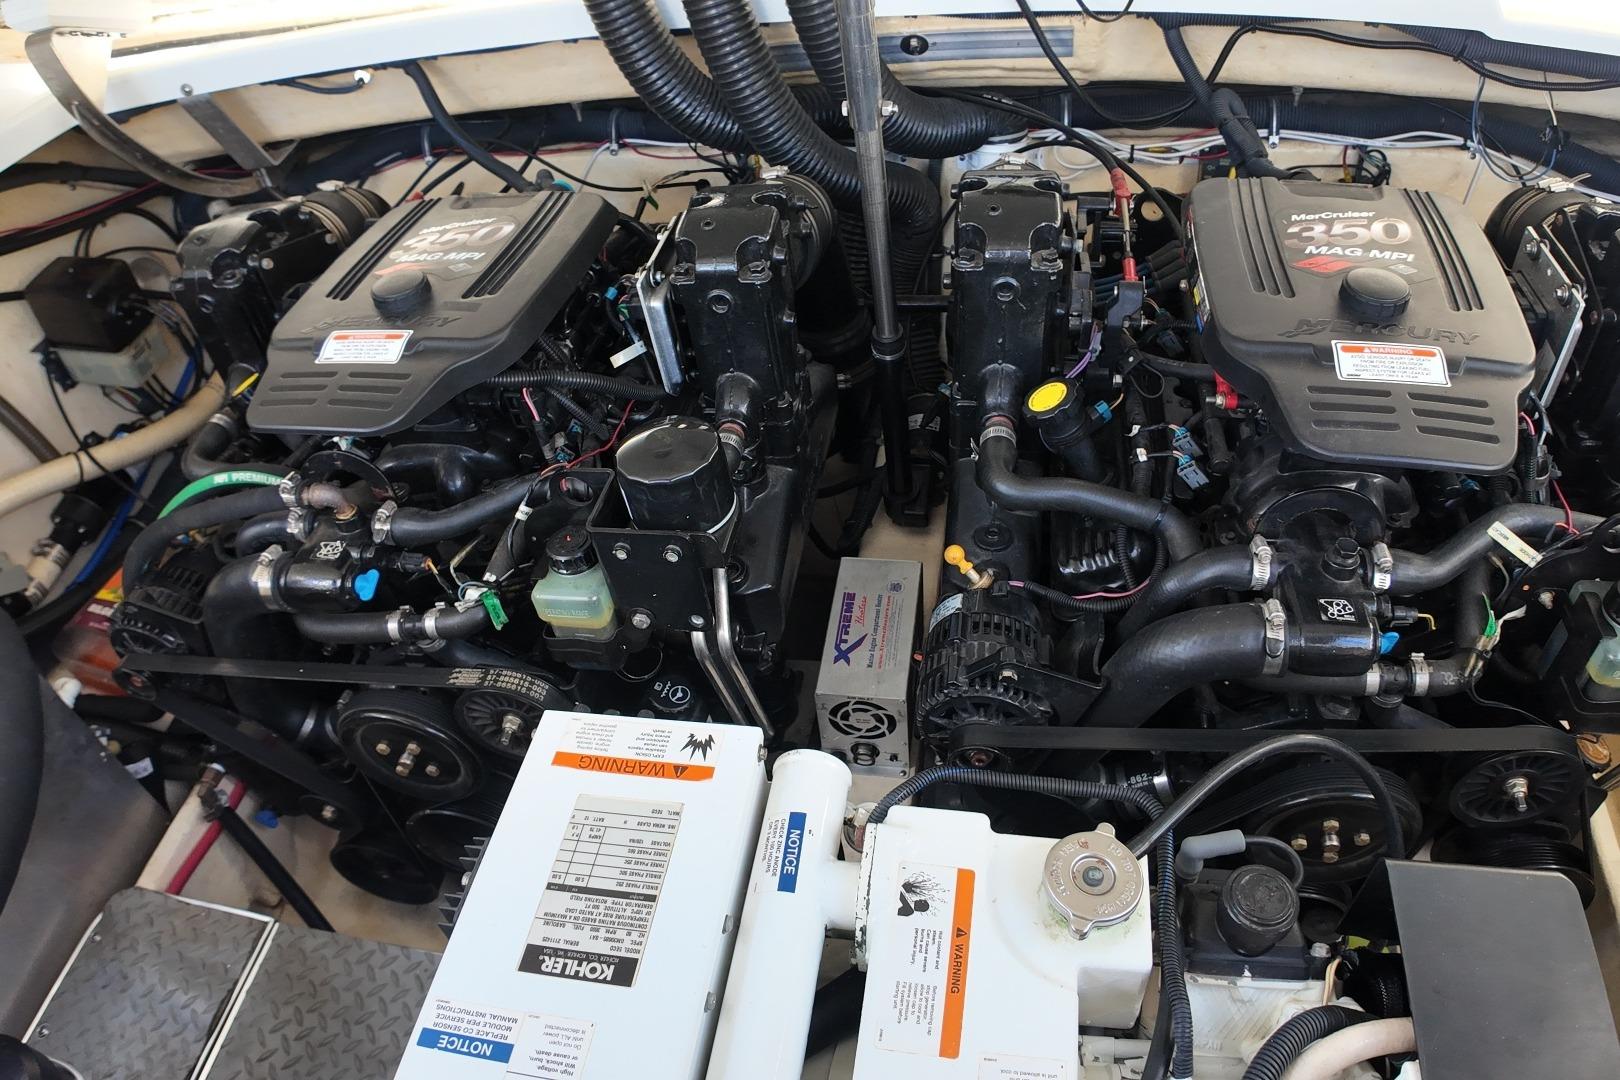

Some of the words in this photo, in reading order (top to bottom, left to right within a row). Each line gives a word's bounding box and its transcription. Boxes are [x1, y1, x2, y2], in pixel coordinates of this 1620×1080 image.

[402, 222, 516, 252] 350
[1284, 218, 1411, 248] 350
[397, 252, 442, 262] MAG
[443, 252, 486, 261] MPI
[1304, 245, 1363, 257] MAG
[1369, 248, 1416, 262] MPI
[833, 592, 868, 667] XTREME
[577, 754, 666, 776] WARNING
[778, 818, 786, 840] CHECK
[784, 829, 801, 875] NOTICE
[772, 855, 780, 877] ANODE
[624, 900, 653, 909] GENERATOR
[543, 911, 568, 919] MAXIMUM
[613, 913, 650, 923] TEMPERATURE
[615, 920, 648, 930] CONTINUOUS
[541, 955, 615, 980] KOHLER
[949, 942, 965, 994] WARNING
[436, 1004, 488, 1018] INSTRUCTIONS
[434, 1012, 465, 1023] SERVICE
[465, 1018, 481, 1026] PER
[487, 1013, 518, 1024] MANUAL
[431, 1021, 462, 1031] SENSOR
[462, 1026, 474, 1034] CO
[481, 1021, 512, 1031] MODULE
[474, 1029, 508, 1040] REPLACE
[437, 1035, 493, 1055] NOTICE
[552, 1051, 570, 1059] cause
[558, 1067, 574, 1077] High
